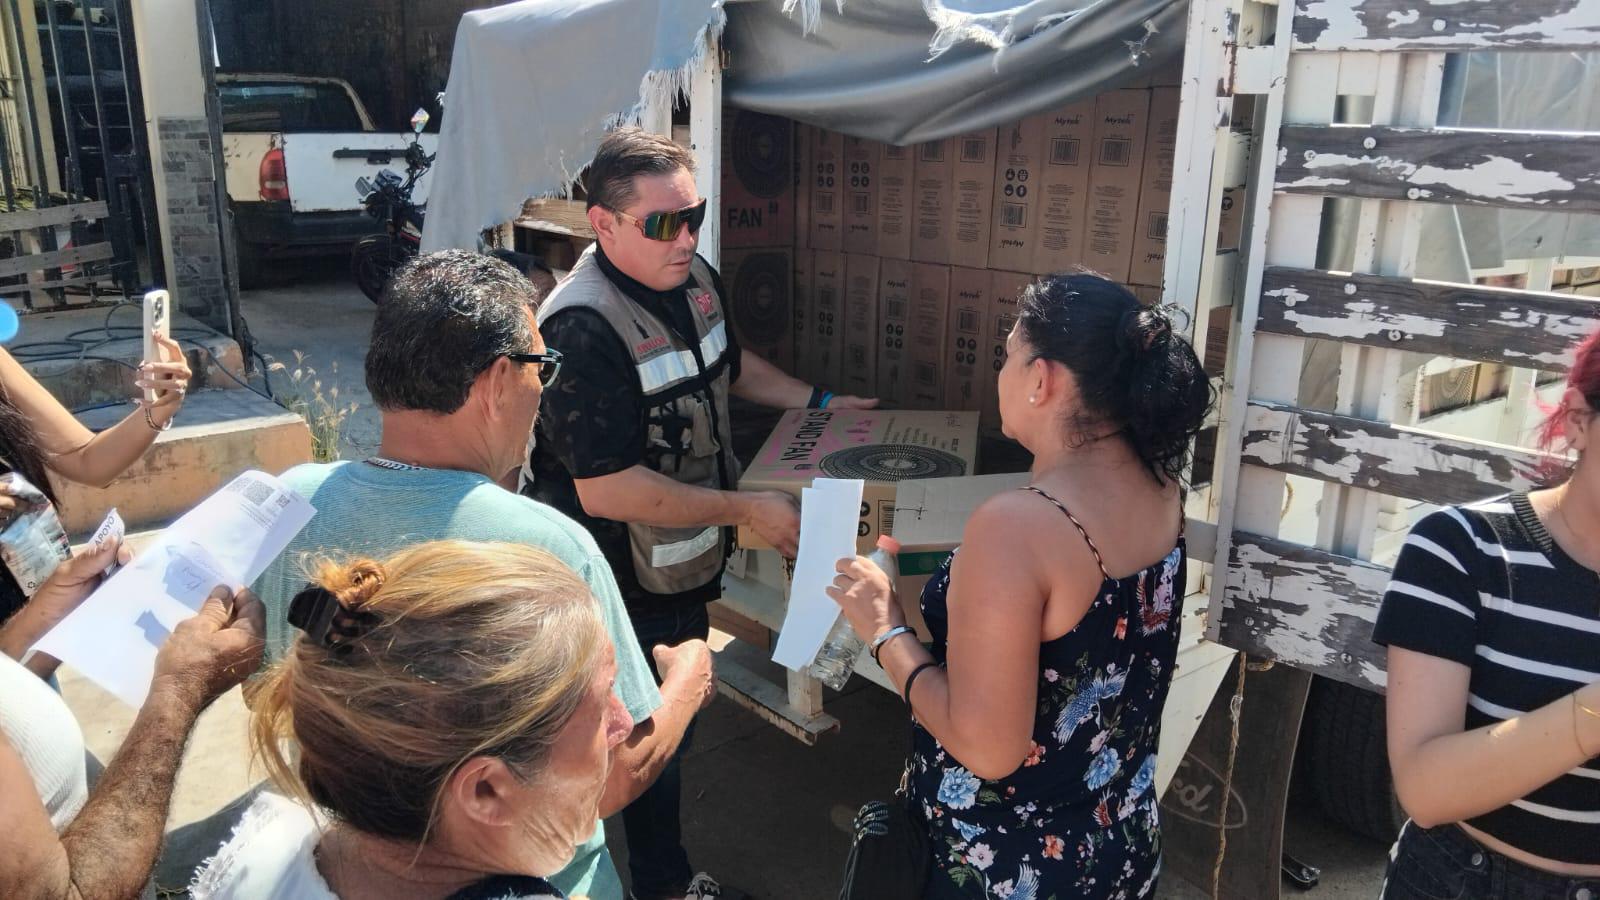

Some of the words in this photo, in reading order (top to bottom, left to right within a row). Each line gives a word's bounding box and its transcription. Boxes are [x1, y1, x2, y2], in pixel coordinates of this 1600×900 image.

[728, 207, 762, 228] FAN
[795, 411, 833, 439] STAND
[780, 441, 817, 461] FAN
